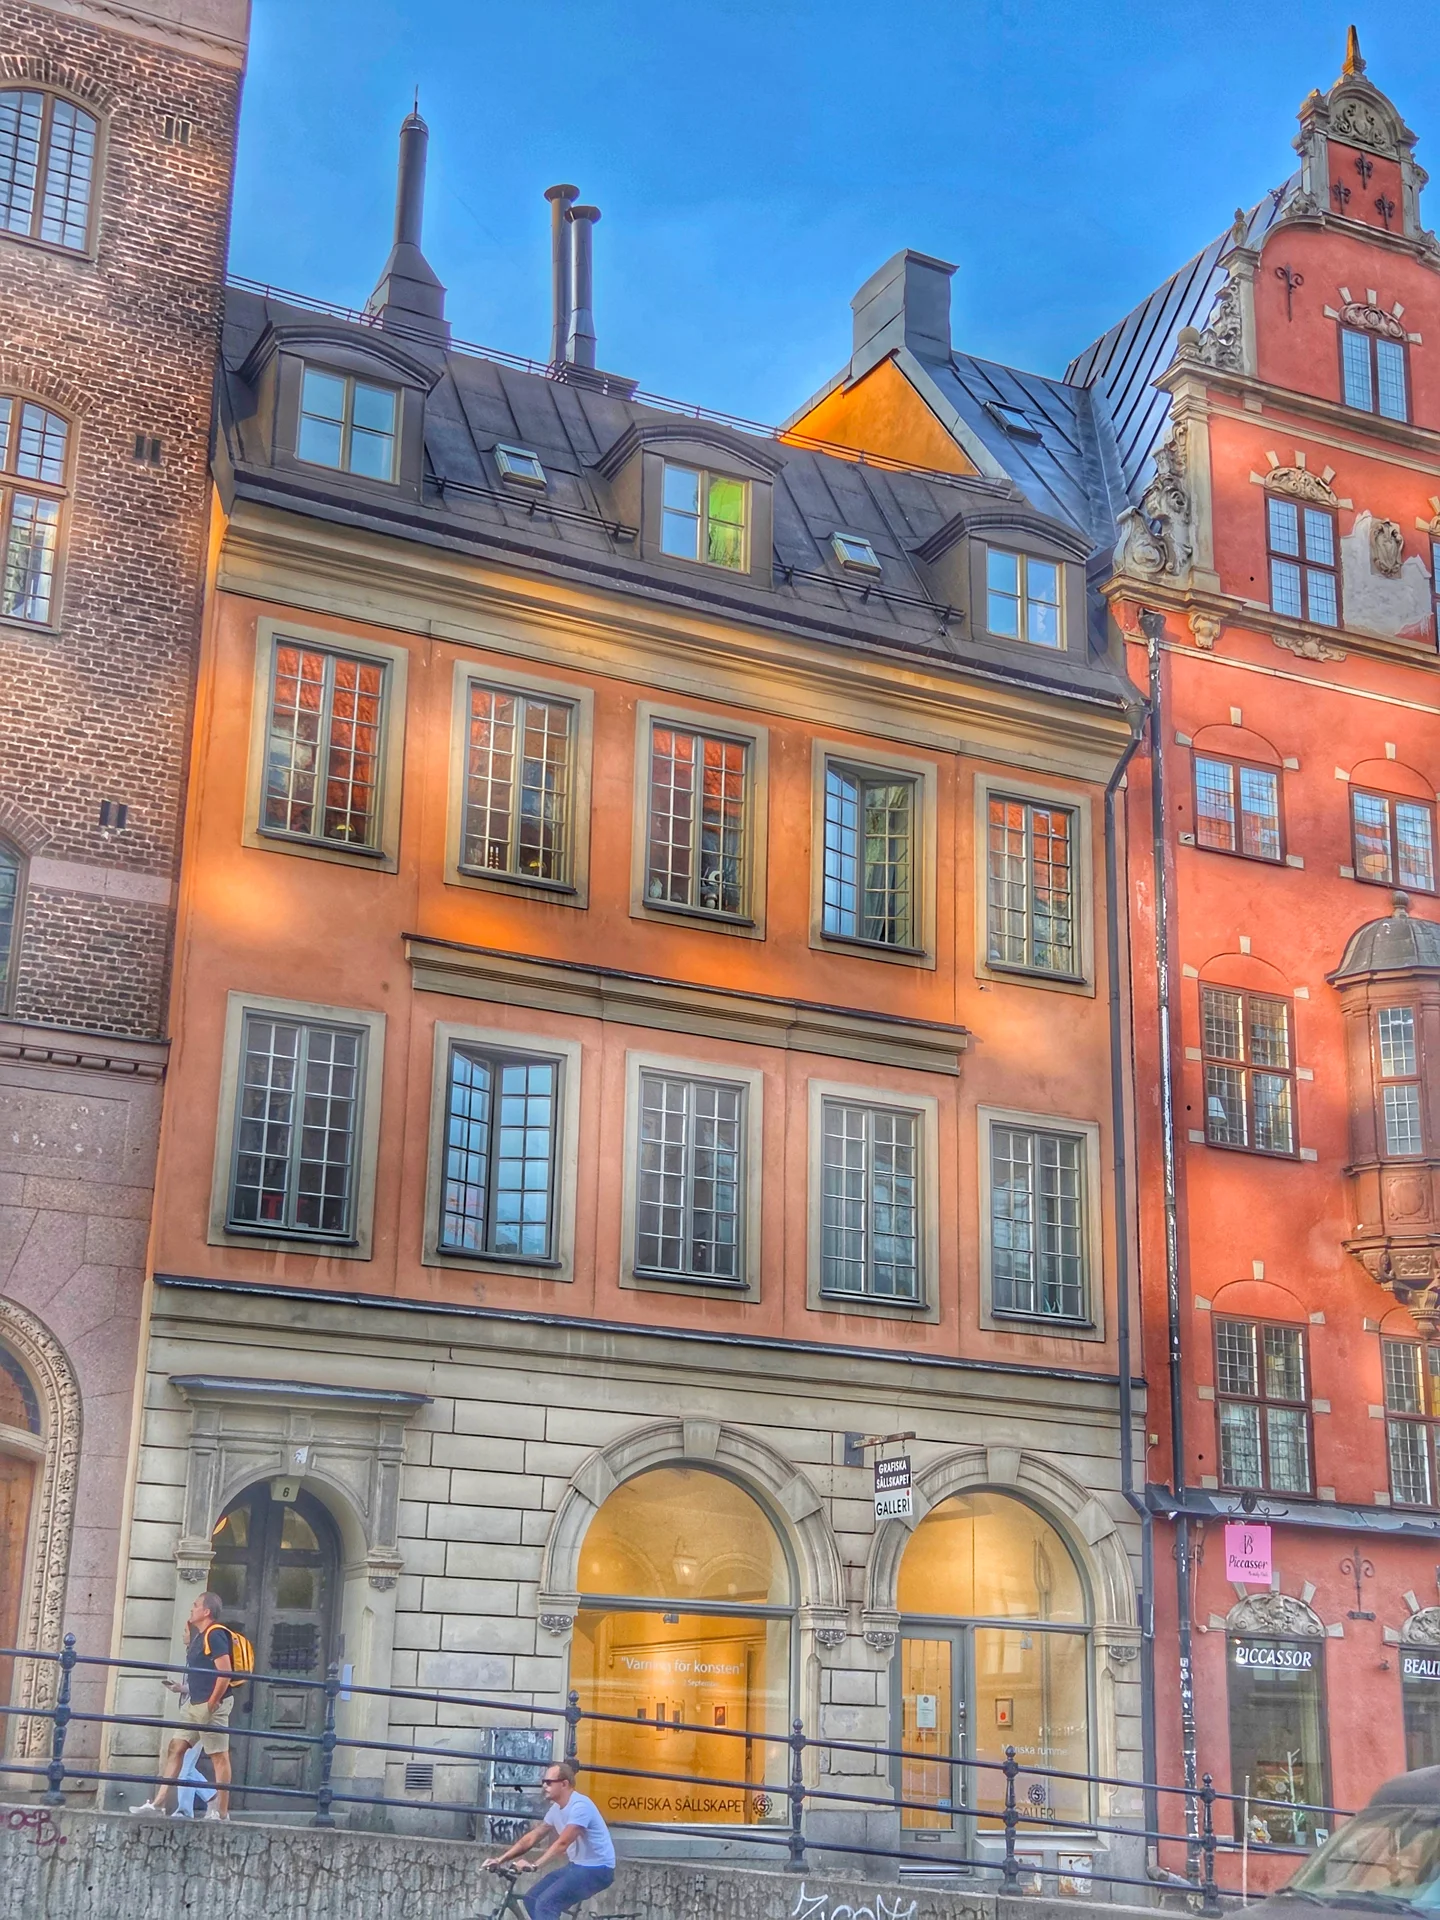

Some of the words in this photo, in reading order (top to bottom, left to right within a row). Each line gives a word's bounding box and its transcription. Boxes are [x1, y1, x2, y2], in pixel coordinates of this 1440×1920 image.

[879, 1460, 907, 1474] GRAFISKA
[876, 1473, 910, 1489] SÄLLSKAPET
[282, 1487, 290, 1497] 6
[876, 1498, 910, 1516] GALLERI
[1235, 1647, 1312, 1667] PICCASSOR
[674, 1659, 691, 1672] för
[607, 1796, 672, 1811] GRAFISKA
[675, 1795, 747, 1813] SÄLLSKAPET
